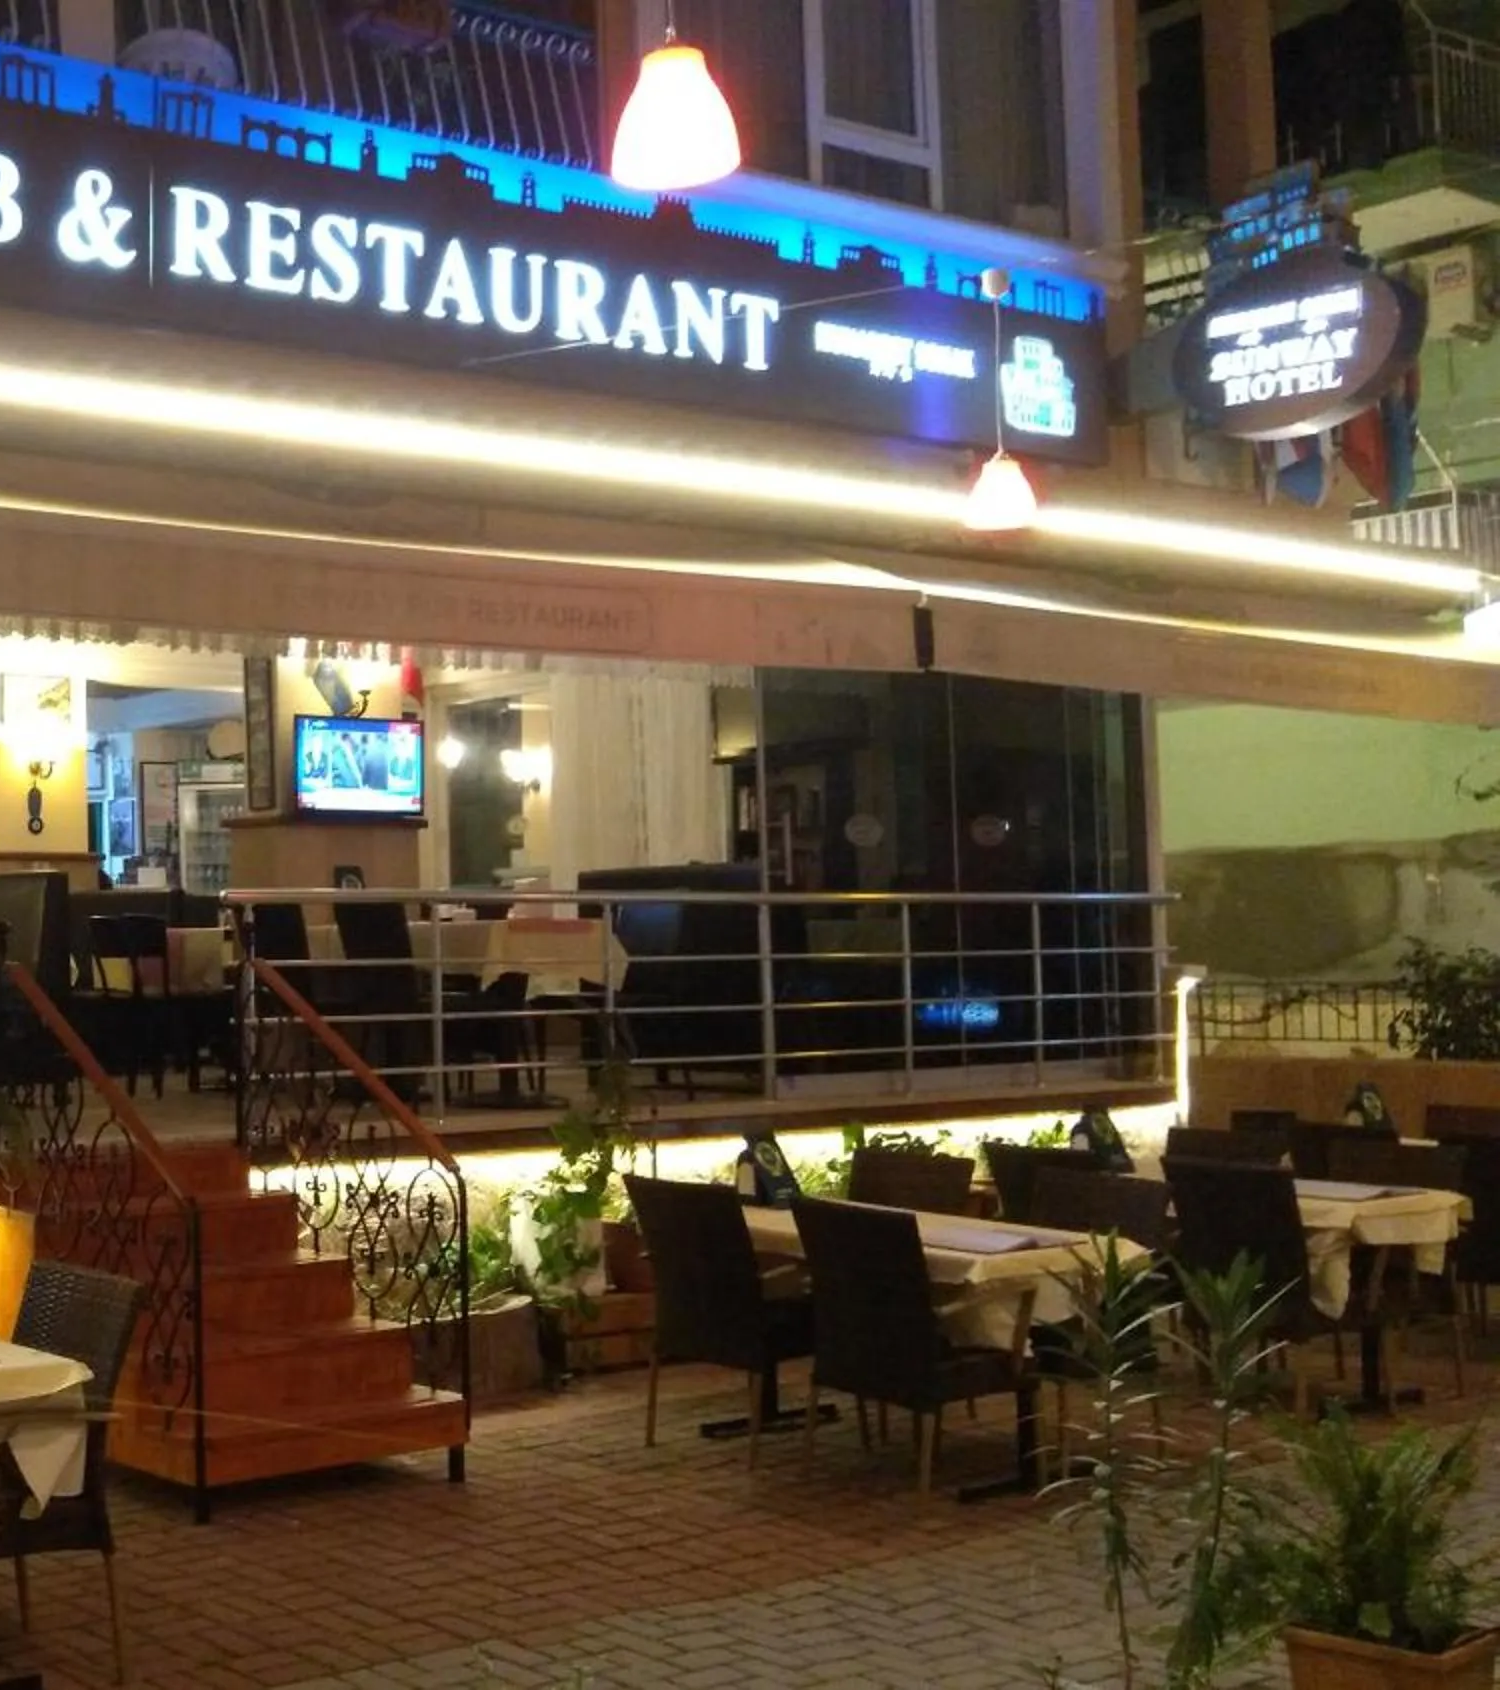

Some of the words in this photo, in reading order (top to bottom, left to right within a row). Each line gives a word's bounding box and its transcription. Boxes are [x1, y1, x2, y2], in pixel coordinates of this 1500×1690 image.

[56, 169, 137, 270] &
[169, 186, 780, 372] RESTAURANT
[1208, 327, 1359, 383] SUNWAY
[1224, 361, 1344, 407] HOTEL
[468, 599, 638, 634] RESTAURANT
